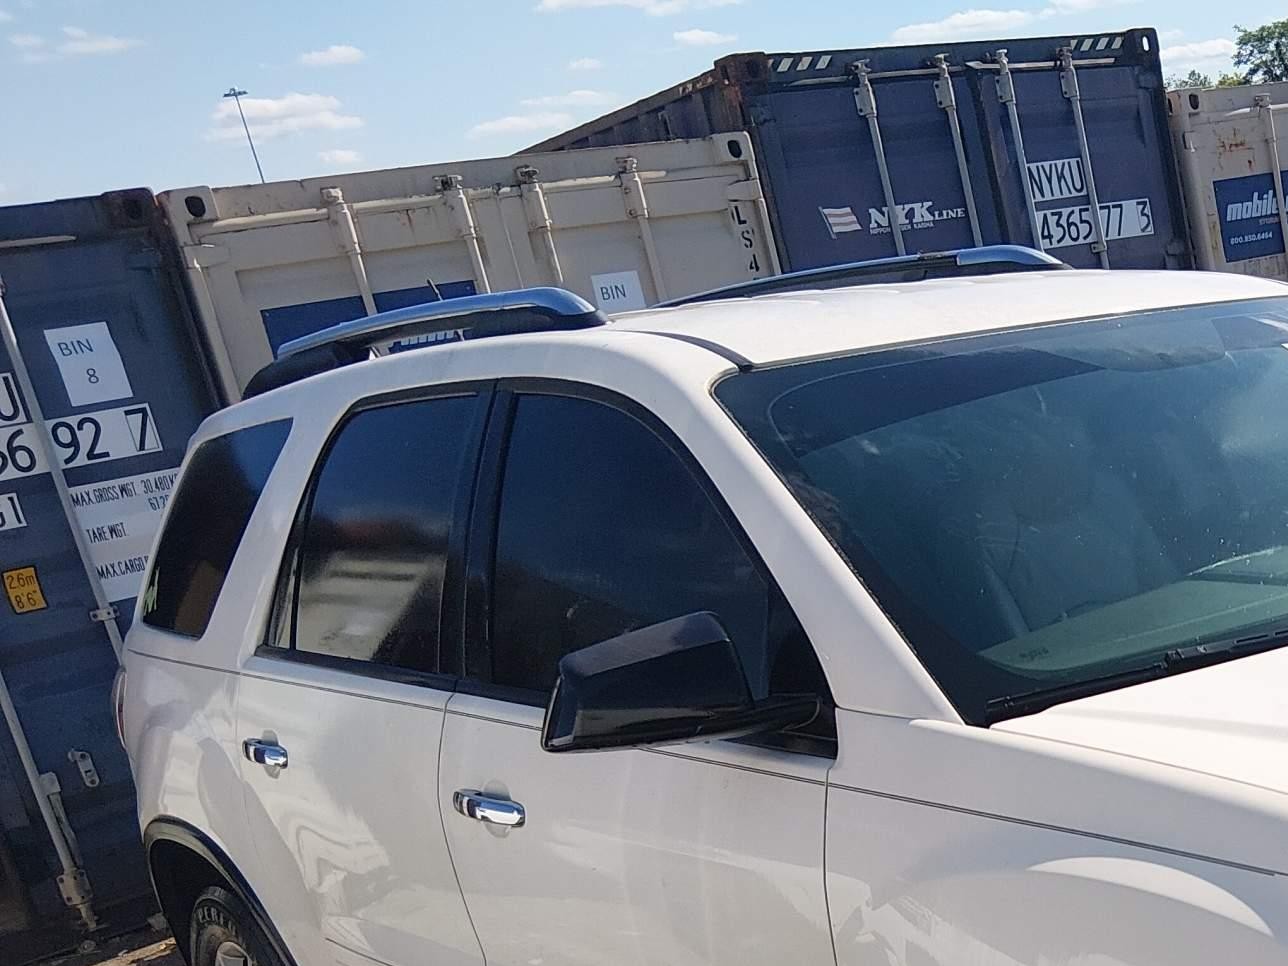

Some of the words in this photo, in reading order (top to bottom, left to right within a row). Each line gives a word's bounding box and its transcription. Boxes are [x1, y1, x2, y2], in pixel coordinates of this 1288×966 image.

[1026, 160, 1085, 200] NYKU
[868, 201, 933, 229] NYK
[934, 208, 965, 220] LINE
[1041, 203, 1124, 246] 436577
[1136, 201, 1152, 233] 3
[600, 284, 626, 301] BIN
[58, 338, 94, 357] BIN
[86, 368, 99, 384] 8
[124, 407, 149, 451] 7
[86, 526, 111, 543] TARE
